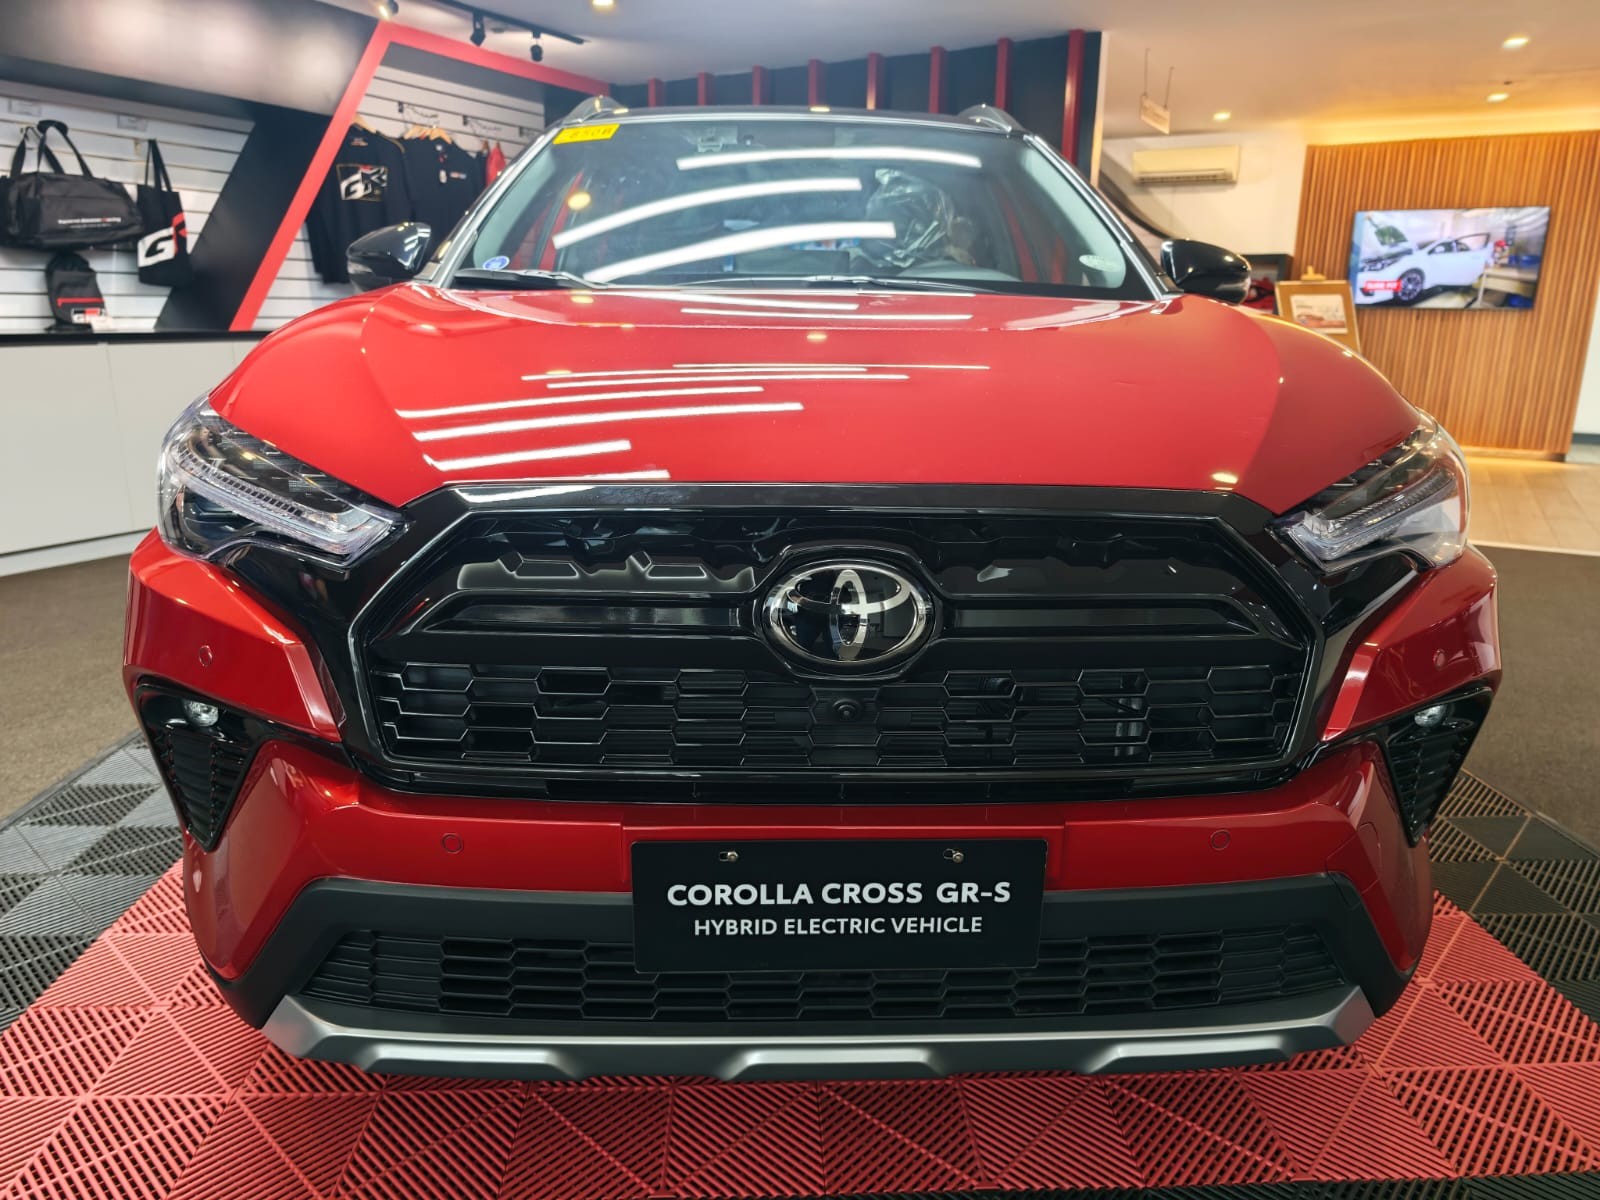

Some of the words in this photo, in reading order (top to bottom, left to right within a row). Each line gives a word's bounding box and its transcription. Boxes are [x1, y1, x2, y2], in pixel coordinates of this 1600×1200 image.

[667, 883, 814, 906] COROLLA
[821, 882, 923, 905] CROSS
[936, 881, 1011, 904] GR-S
[694, 919, 778, 936] HYBRID
[783, 918, 886, 935] ELECTRIC
[891, 916, 983, 934] VEHICLE
